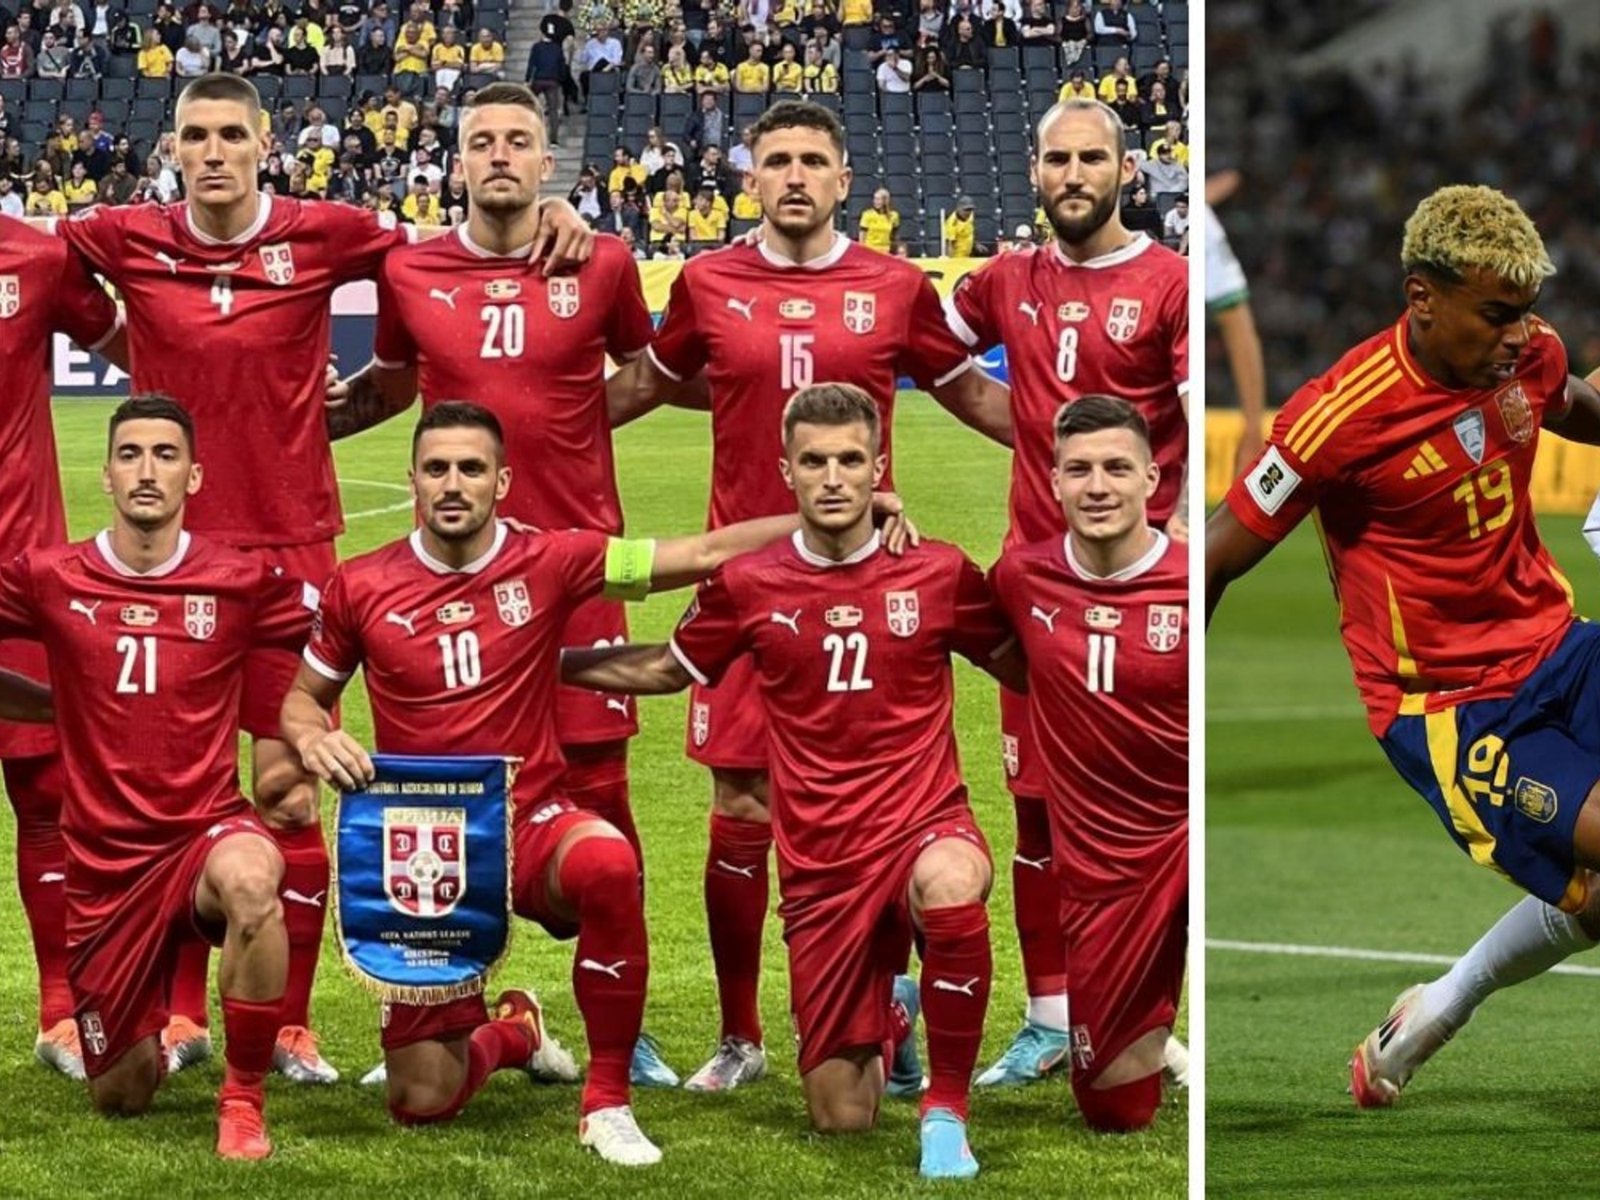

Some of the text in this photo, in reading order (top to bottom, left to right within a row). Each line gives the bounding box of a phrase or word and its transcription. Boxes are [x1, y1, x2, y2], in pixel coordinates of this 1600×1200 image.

[210, 274, 234, 316] 4
[480, 304, 524, 358] 20
[1056, 327, 1079, 382] 8
[779, 333, 815, 389] 15
[1453, 459, 1514, 539] 19
[116, 635, 156, 694] 21
[437, 629, 481, 689] 10
[823, 631, 873, 692] 22
[1087, 633, 1116, 693] 11
[1462, 734, 1510, 807] 19
